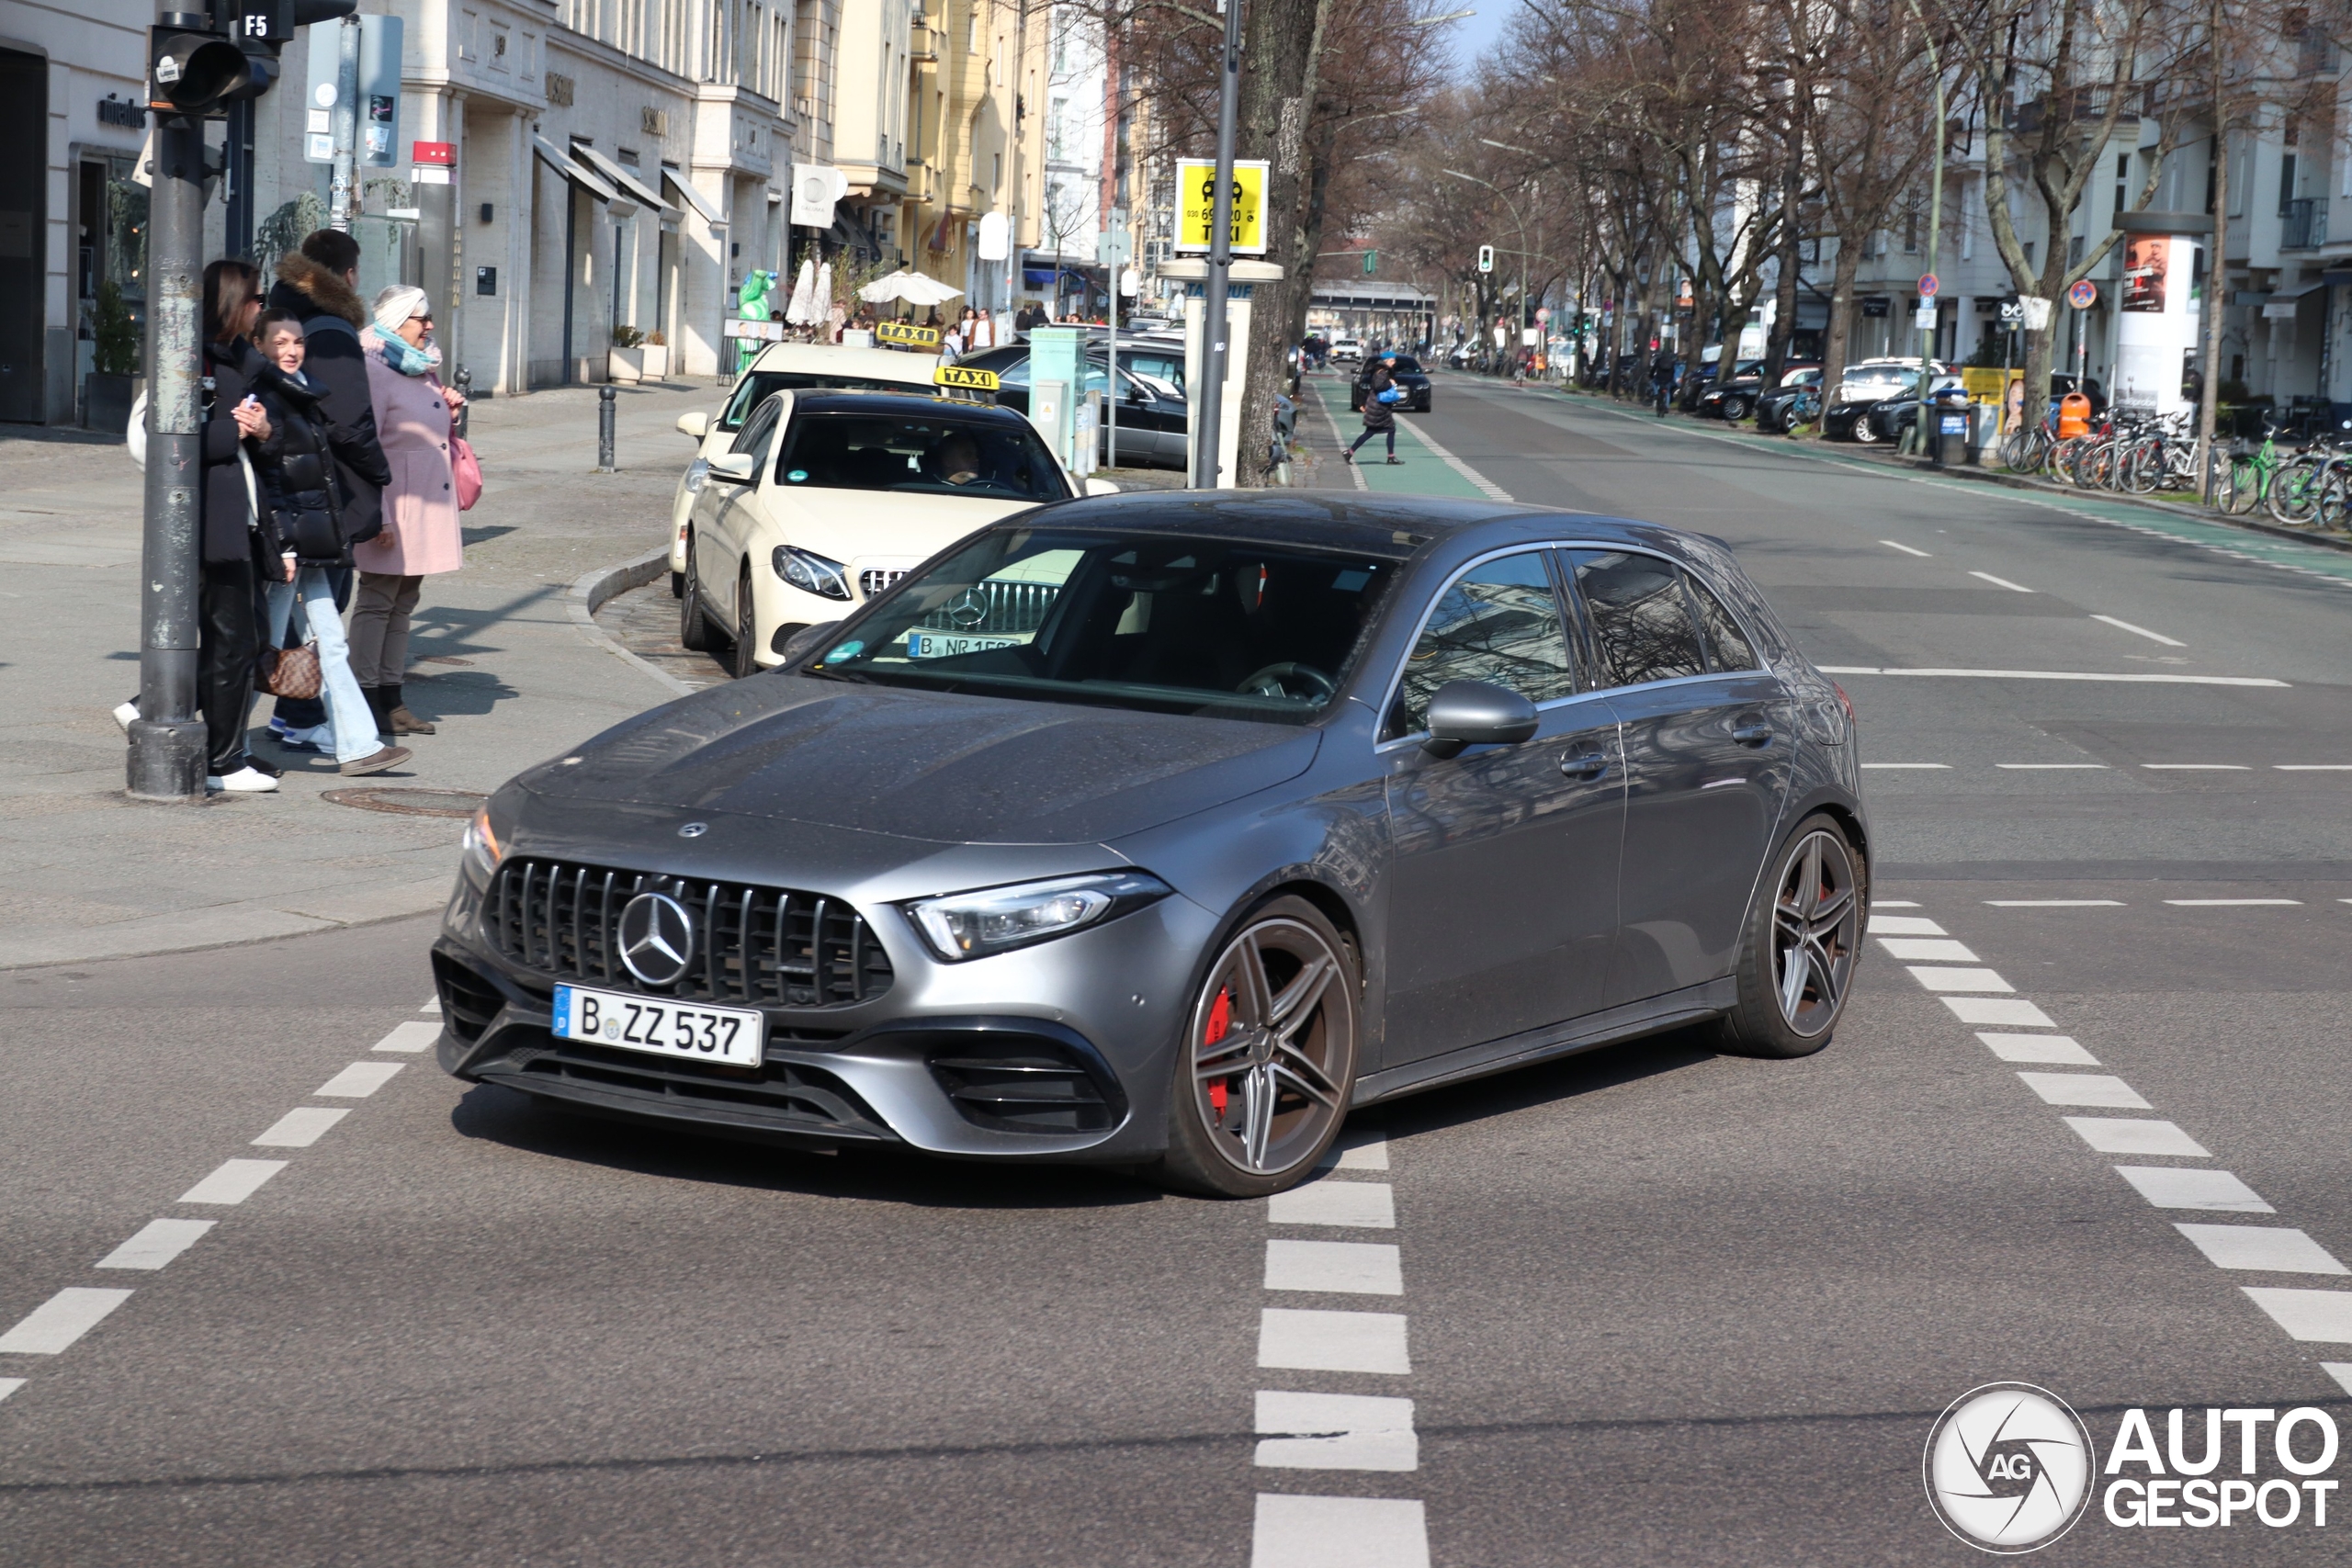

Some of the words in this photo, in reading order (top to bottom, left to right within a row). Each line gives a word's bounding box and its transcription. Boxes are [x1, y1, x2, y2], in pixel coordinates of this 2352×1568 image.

[245, 15, 267, 37] F5
[1202, 224, 1240, 243] TI
[887, 325, 929, 341] TAXI
[945, 369, 990, 386] TAXI
[922, 637, 933, 655] B
[582, 997, 600, 1035] B
[624, 1003, 664, 1047] ZZ
[675, 1011, 741, 1055] 537
